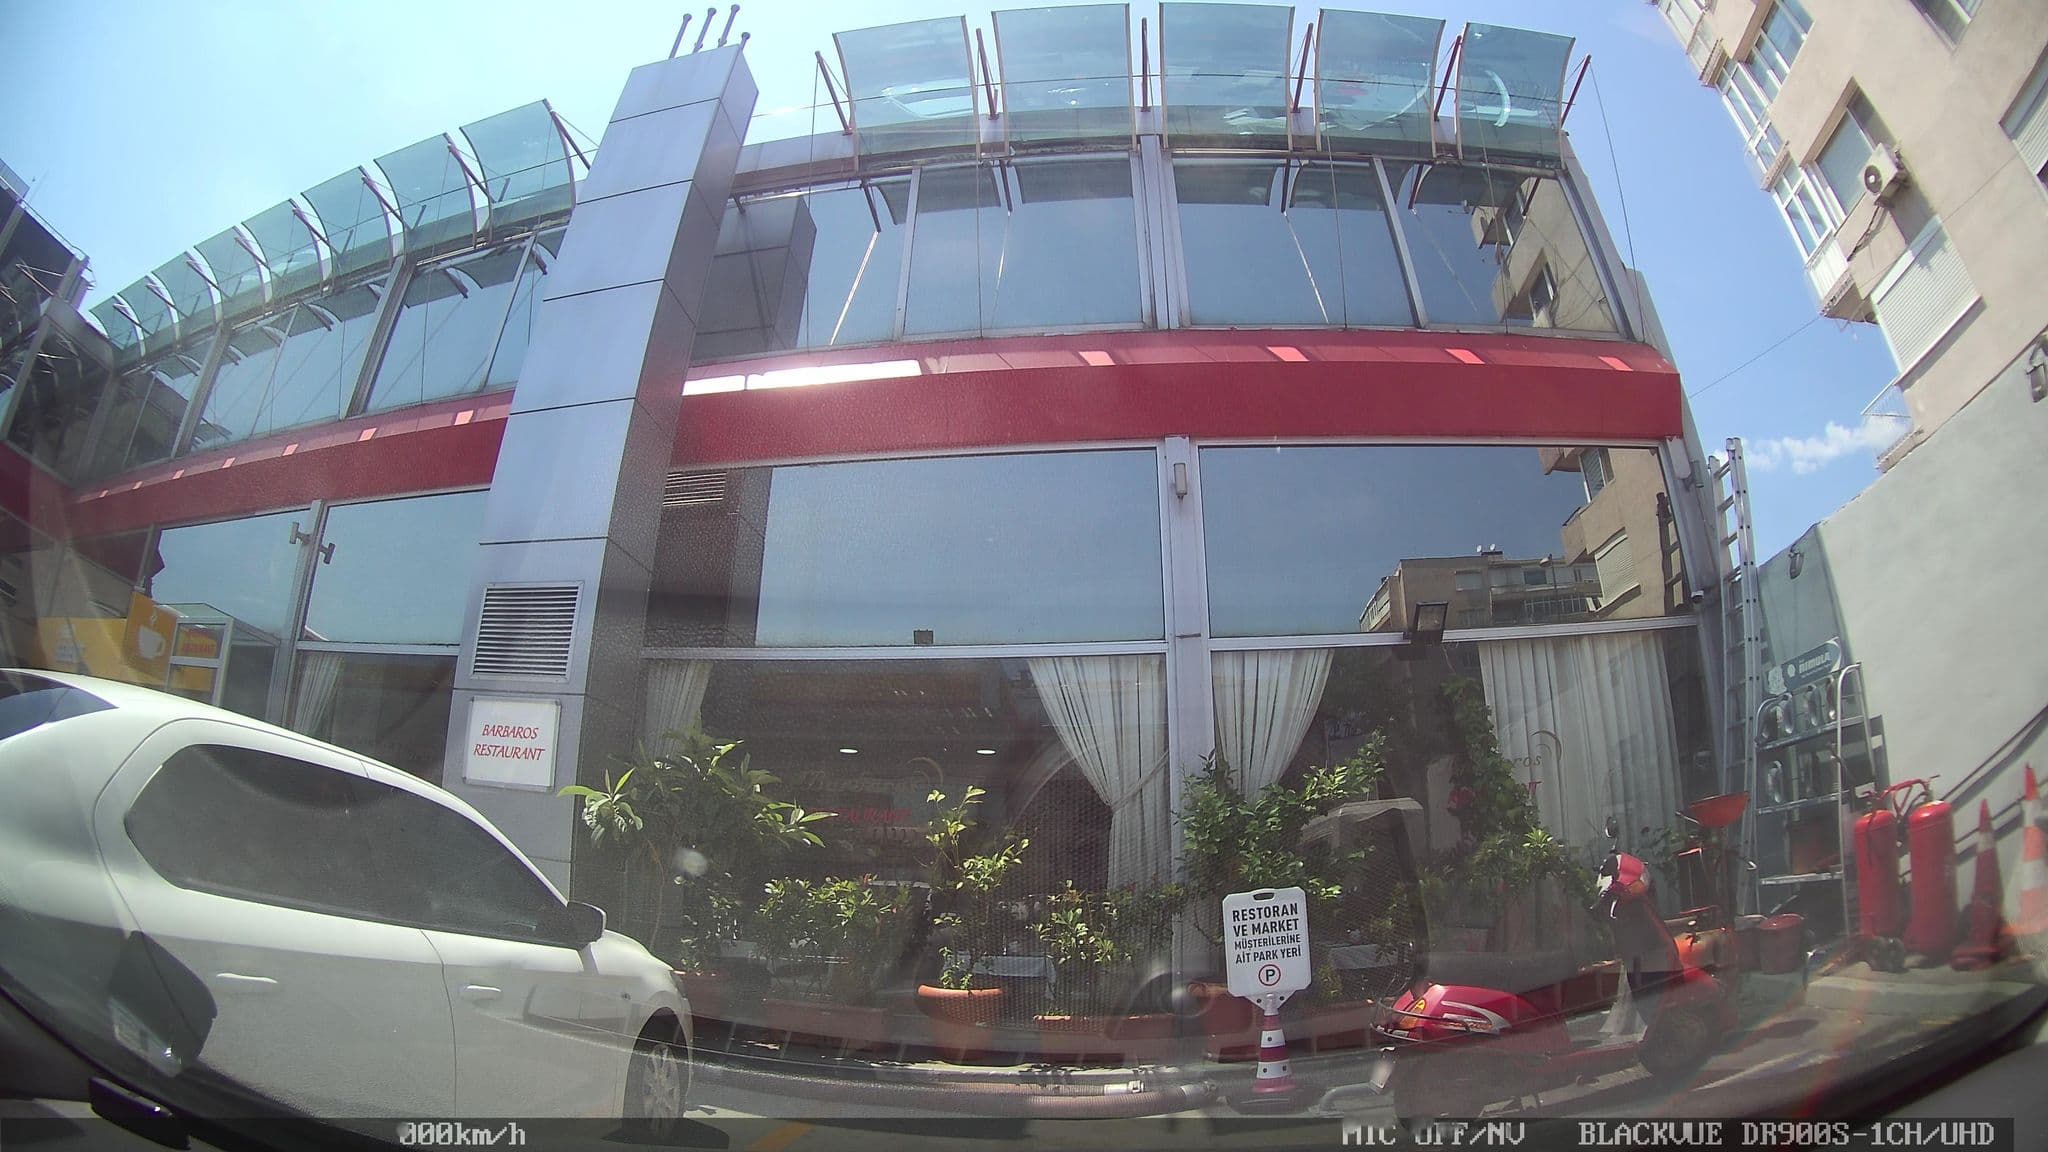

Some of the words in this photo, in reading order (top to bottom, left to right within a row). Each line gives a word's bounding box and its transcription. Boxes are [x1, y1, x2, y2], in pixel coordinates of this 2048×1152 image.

[482, 725, 539, 739] BARBAROS
[473, 744, 545, 760] RESTAURANT
[1232, 902, 1298, 922] RESTORAN
[1233, 924, 1248, 937] VE
[1252, 918, 1299, 935] MARKET
[1234, 933, 1301, 951] MÜŞTERİLERİNE
[1235, 951, 1251, 964] AİT
[1253, 949, 1278, 962] PARK
[1280, 944, 1301, 959] YERİ
